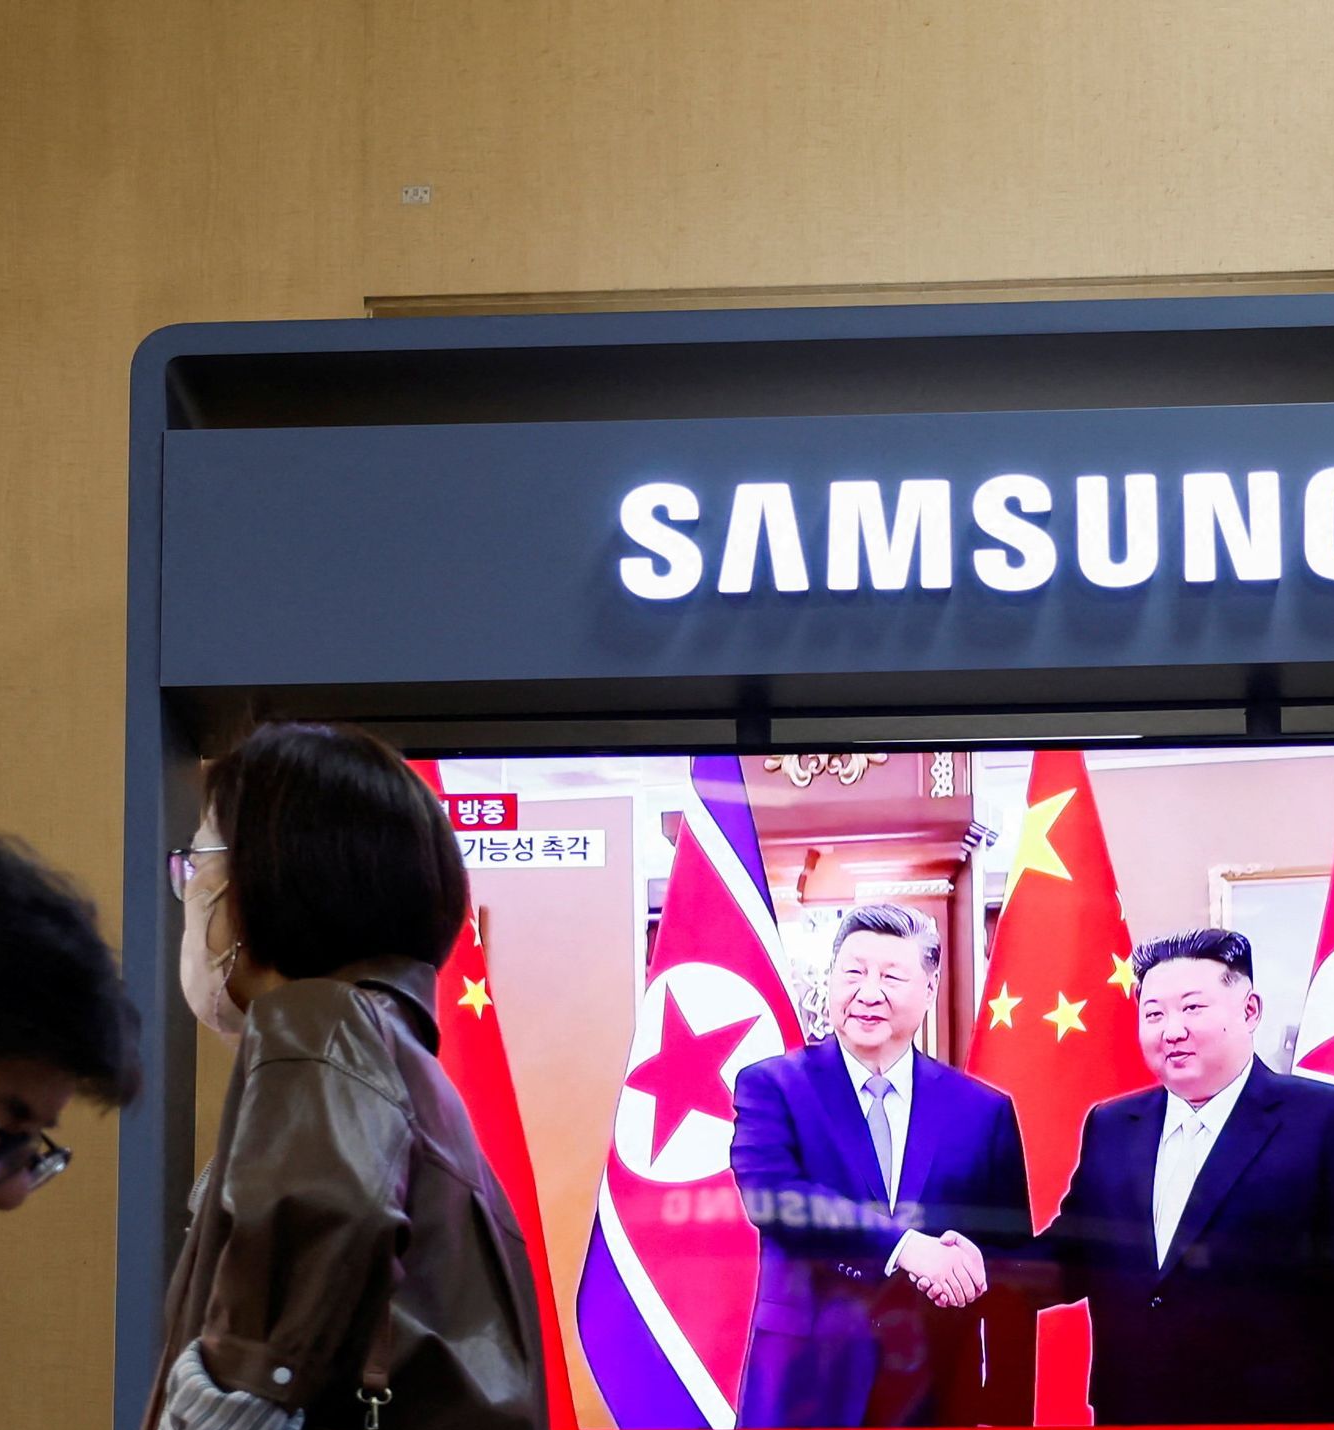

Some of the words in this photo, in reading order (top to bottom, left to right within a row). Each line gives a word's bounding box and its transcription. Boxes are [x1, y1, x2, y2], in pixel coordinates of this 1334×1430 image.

[457, 799, 506, 825] 방중
[463, 836, 534, 862] 가능성
[541, 835, 591, 862] 촉각
